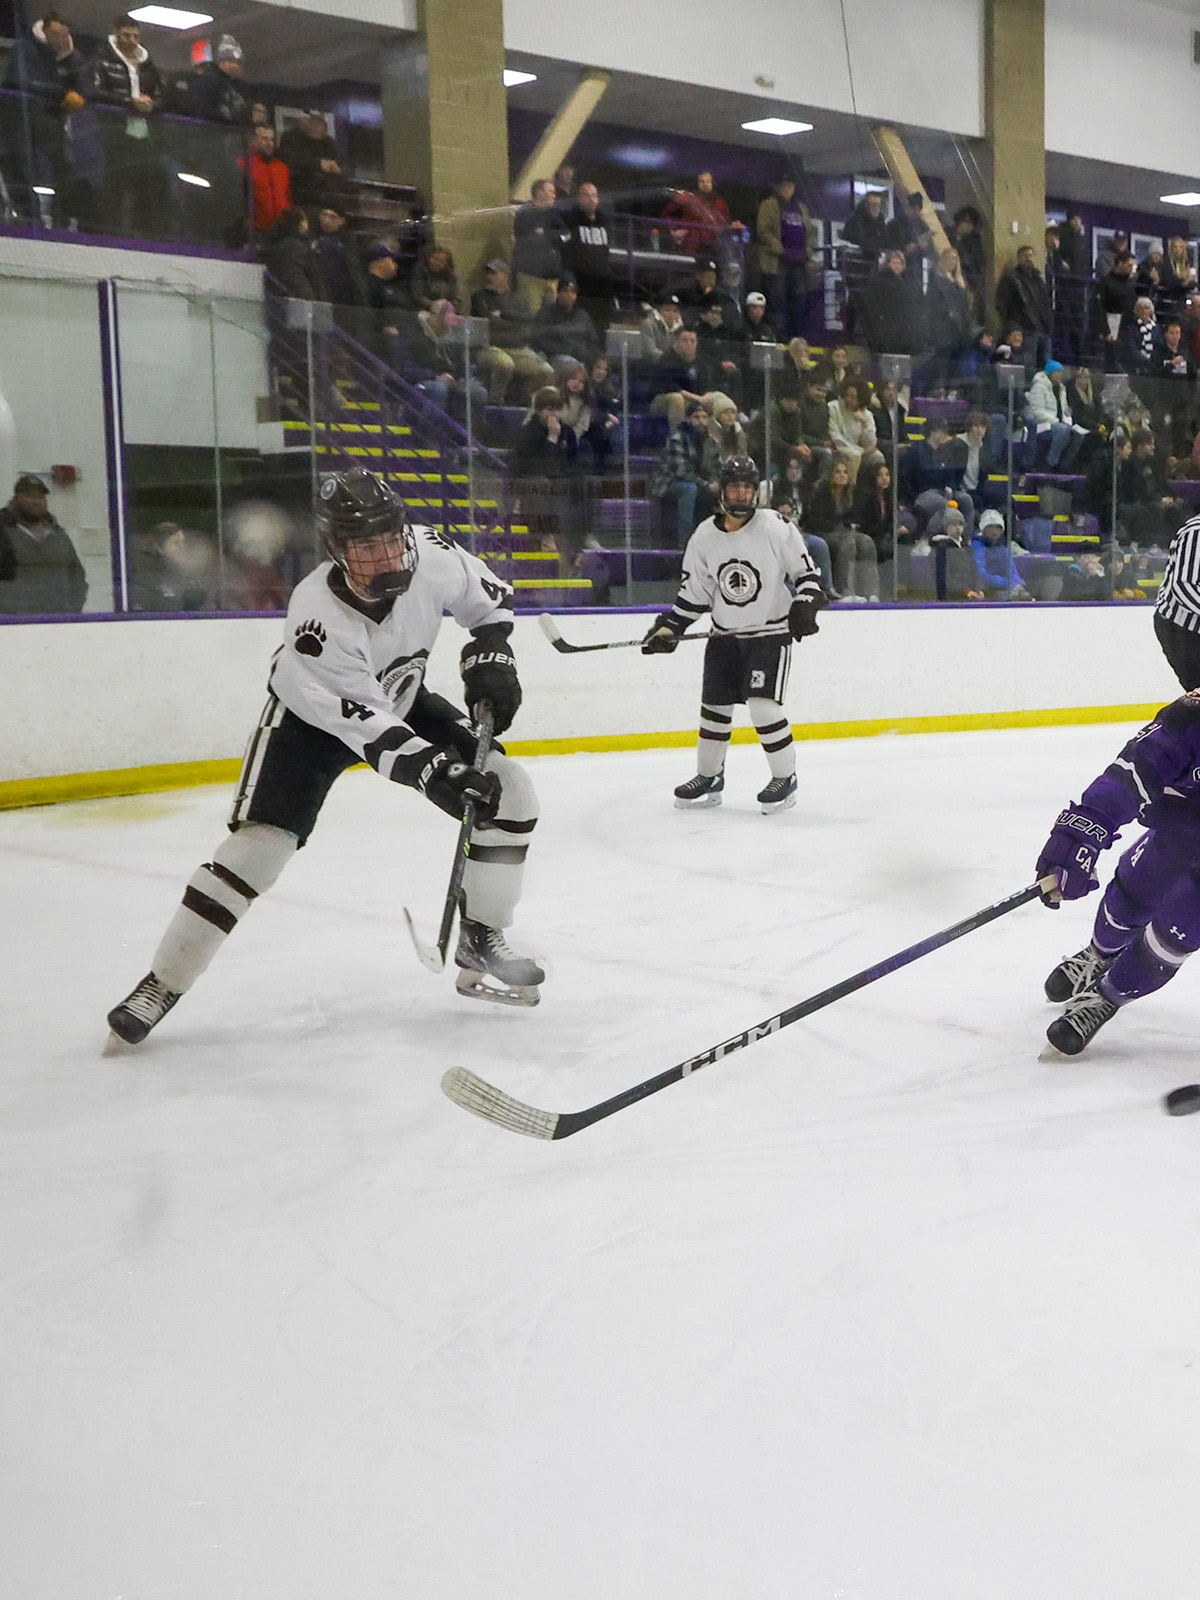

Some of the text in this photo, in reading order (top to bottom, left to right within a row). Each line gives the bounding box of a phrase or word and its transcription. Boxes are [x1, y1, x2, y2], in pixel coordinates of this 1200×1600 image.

[464, 651, 517, 671] AUER
[341, 698, 376, 722] 4
[1057, 811, 1109, 843] UER
[1074, 846, 1092, 874] CA
[682, 1015, 781, 1077] CCM
